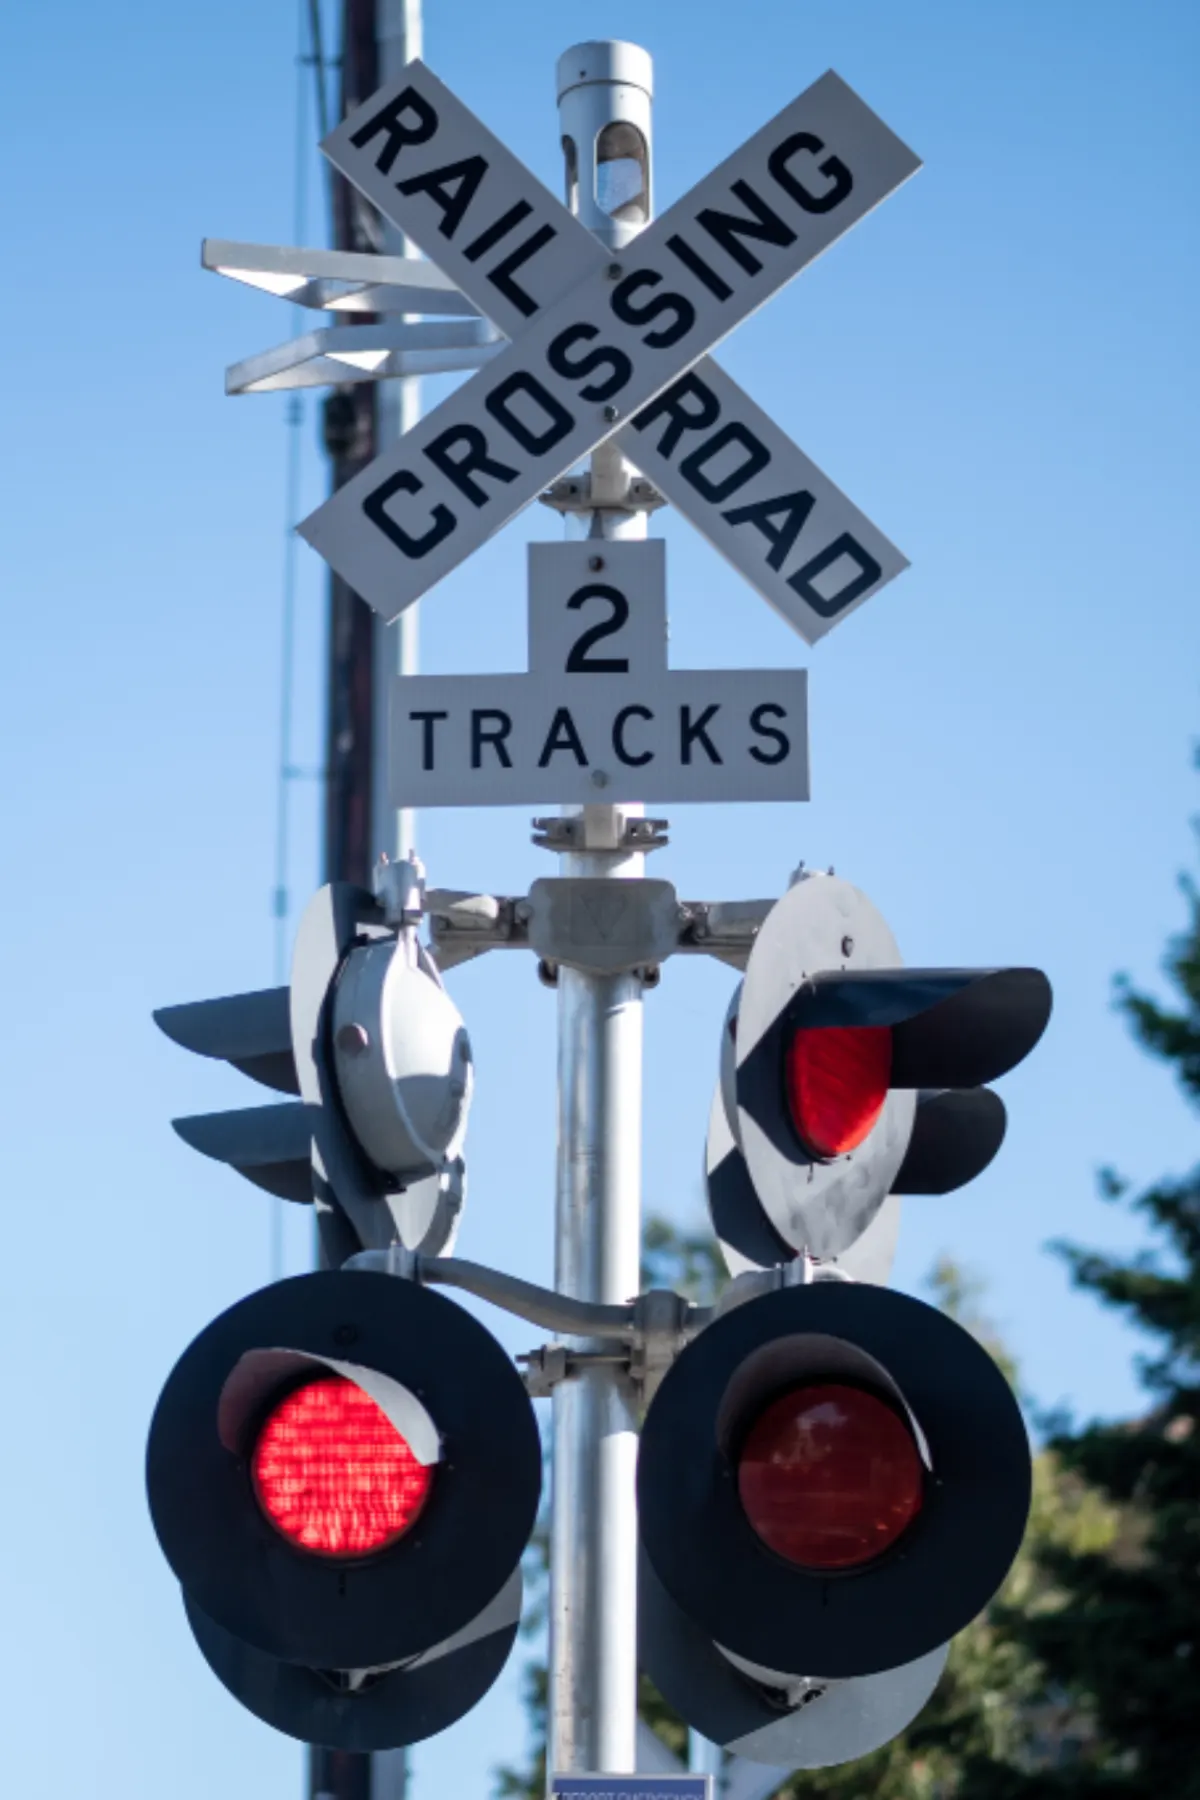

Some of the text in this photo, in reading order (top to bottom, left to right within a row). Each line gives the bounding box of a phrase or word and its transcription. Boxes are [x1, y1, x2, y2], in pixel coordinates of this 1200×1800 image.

[348, 85, 882, 618] RAIL ROAD
[361, 131, 854, 560] CROSSING
[409, 703, 791, 771] TRACKS
[565, 583, 629, 673] 2
